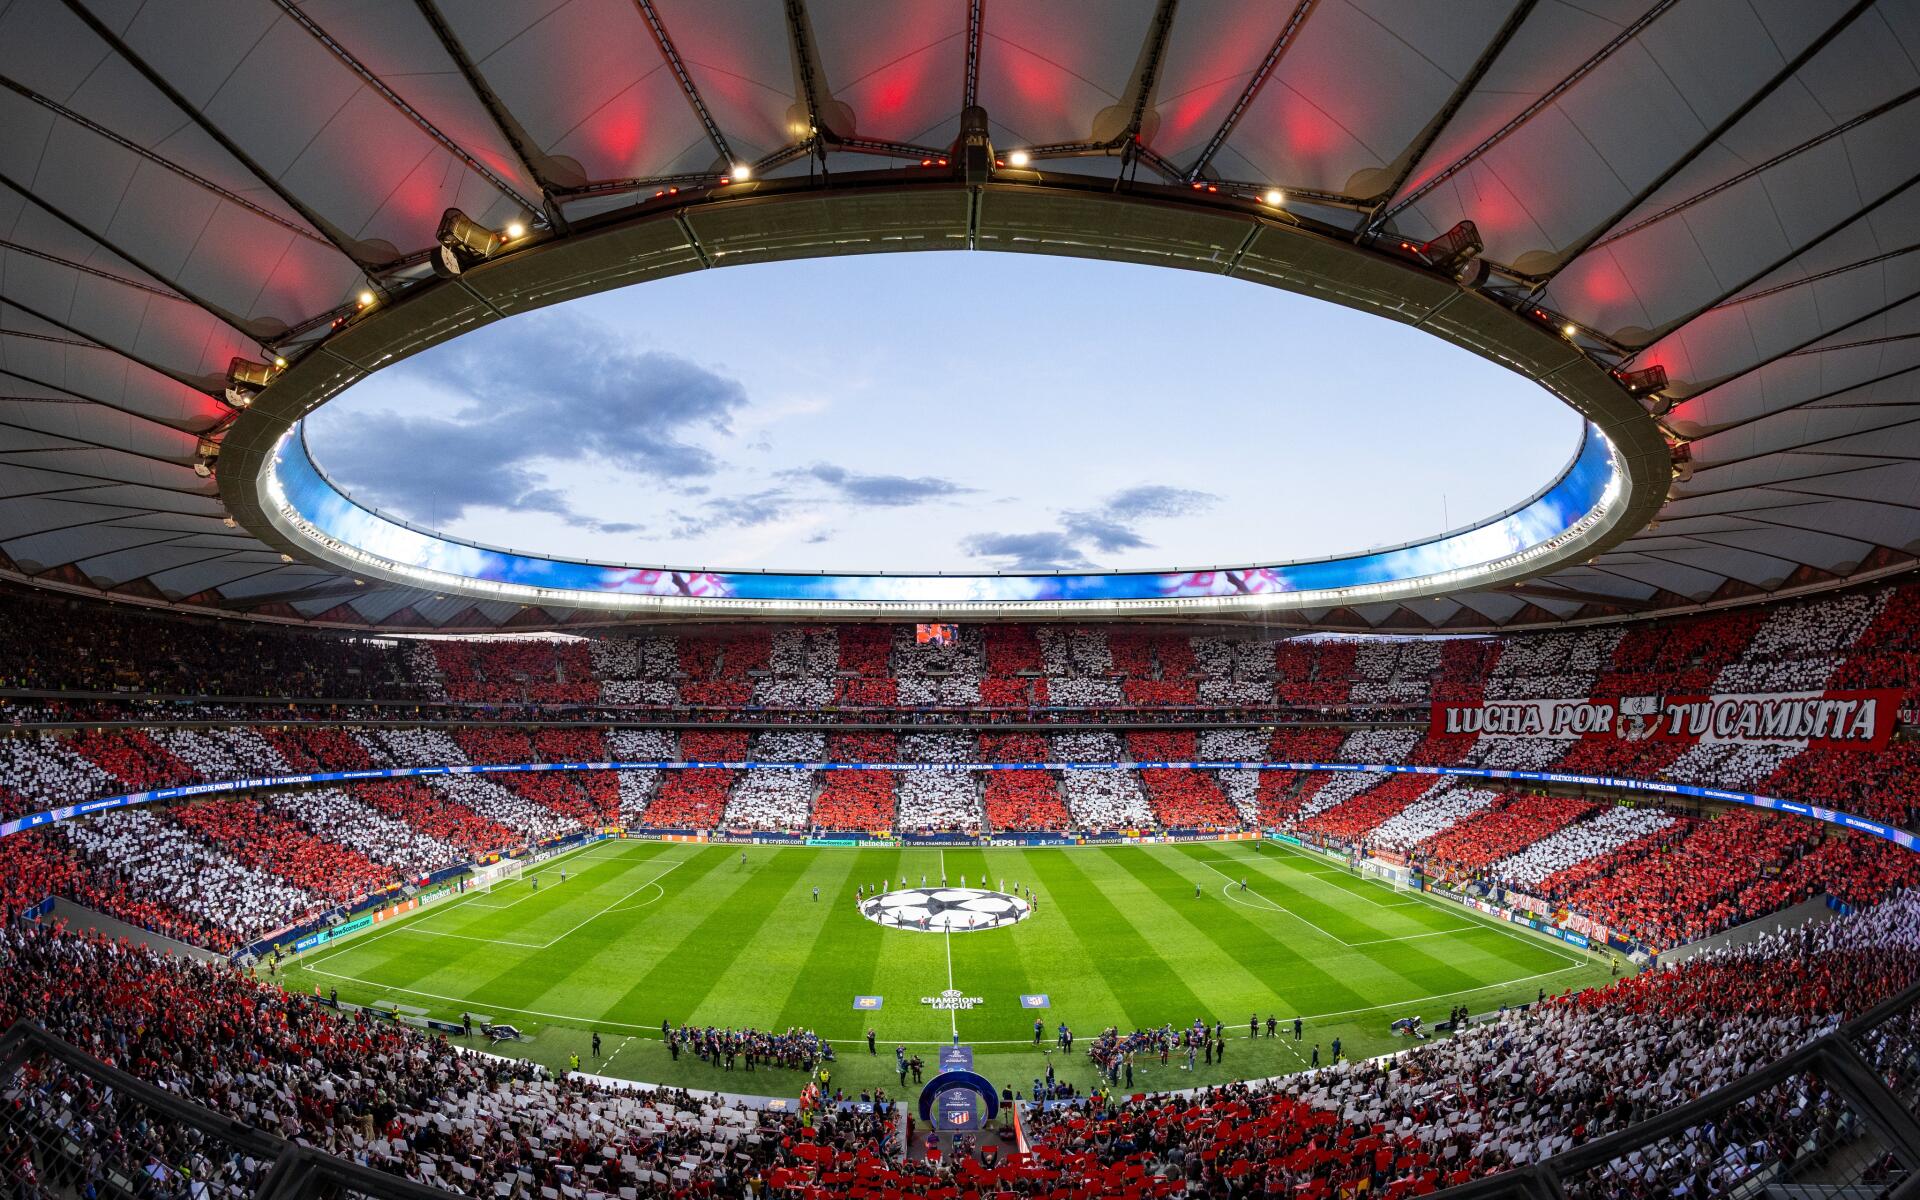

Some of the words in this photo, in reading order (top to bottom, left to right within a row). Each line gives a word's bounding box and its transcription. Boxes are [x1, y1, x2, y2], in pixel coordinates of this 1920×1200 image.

[1446, 705, 1541, 734] LUCHA
[1553, 704, 1613, 734] POR
[1667, 702, 1712, 736] TU
[1715, 698, 1877, 740] CAMISETA
[215, 782, 233, 790] MADRID
[859, 839, 894, 847] Heineken
[534, 852, 550, 862] PEPSI
[421, 888, 451, 905] Heineken
[1432, 886, 1463, 902] mastercard
[297, 937, 317, 949] RECYCLE
